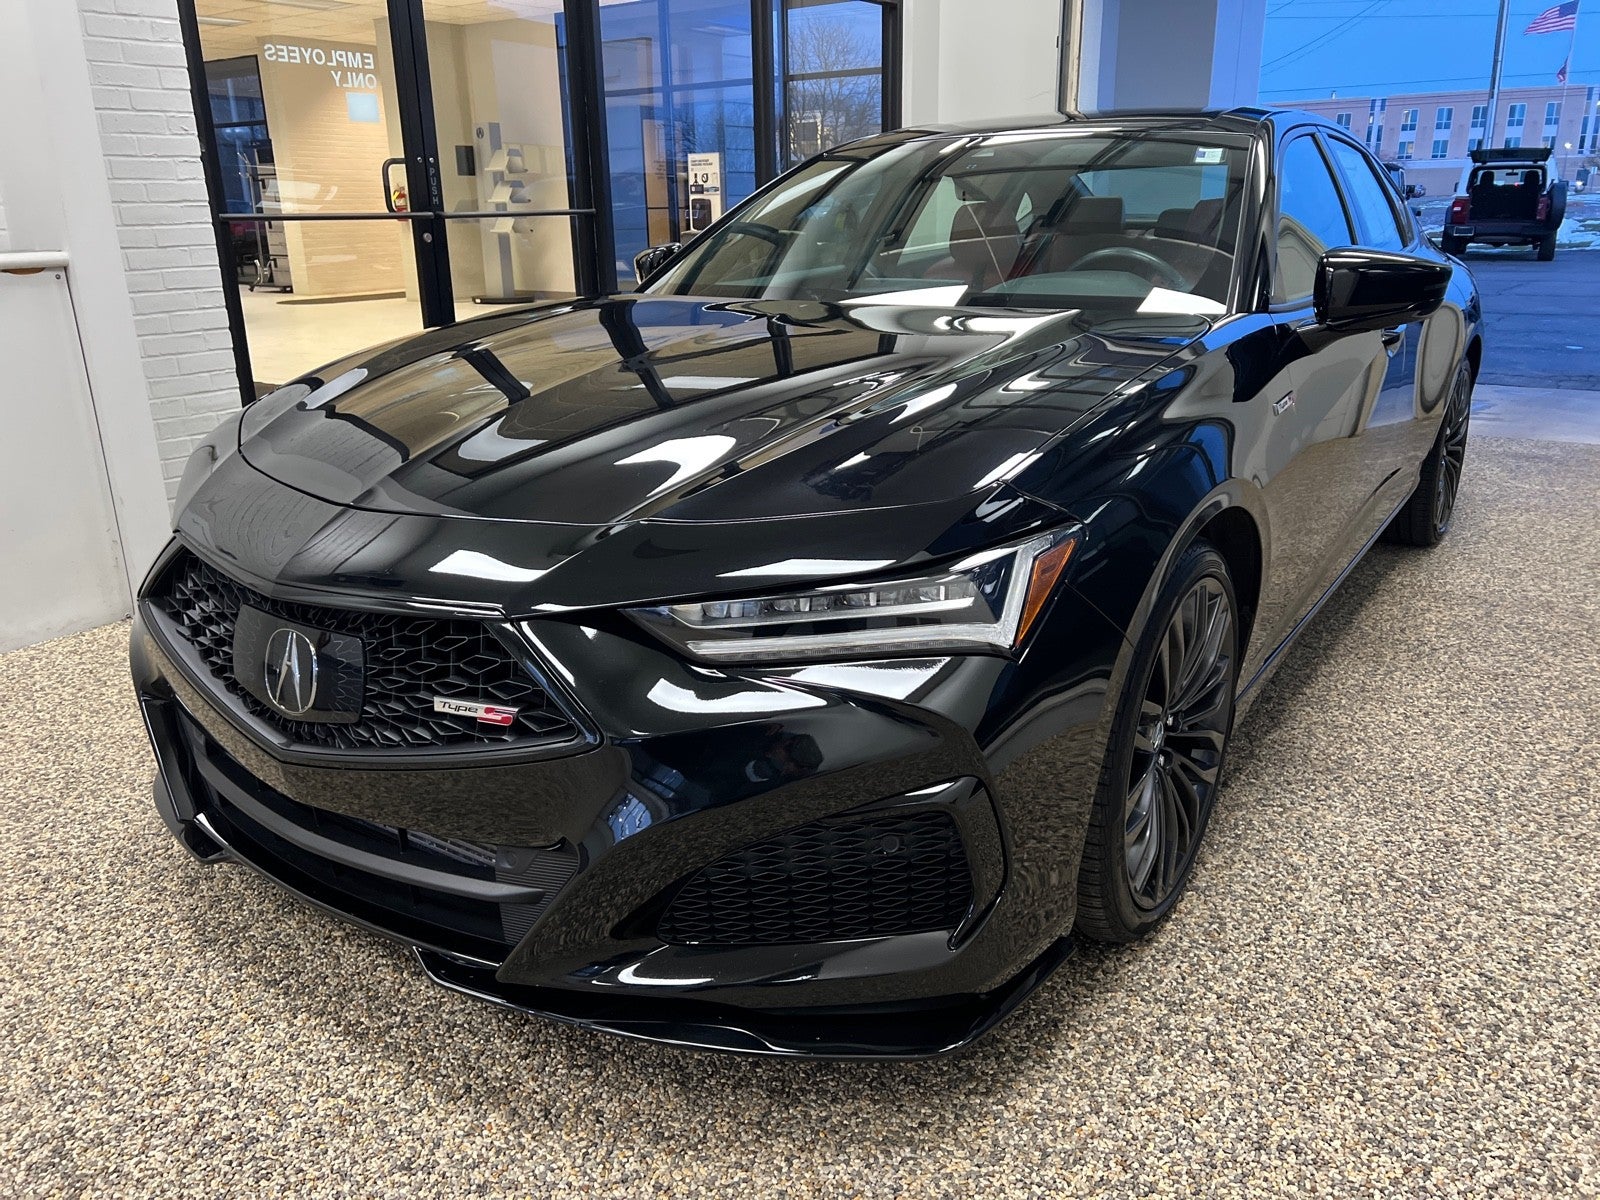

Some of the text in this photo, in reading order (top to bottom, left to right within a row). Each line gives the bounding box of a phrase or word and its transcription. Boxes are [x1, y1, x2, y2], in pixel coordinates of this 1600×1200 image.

[429, 167, 439, 205] PUSH
[439, 700, 516, 727] Type S
